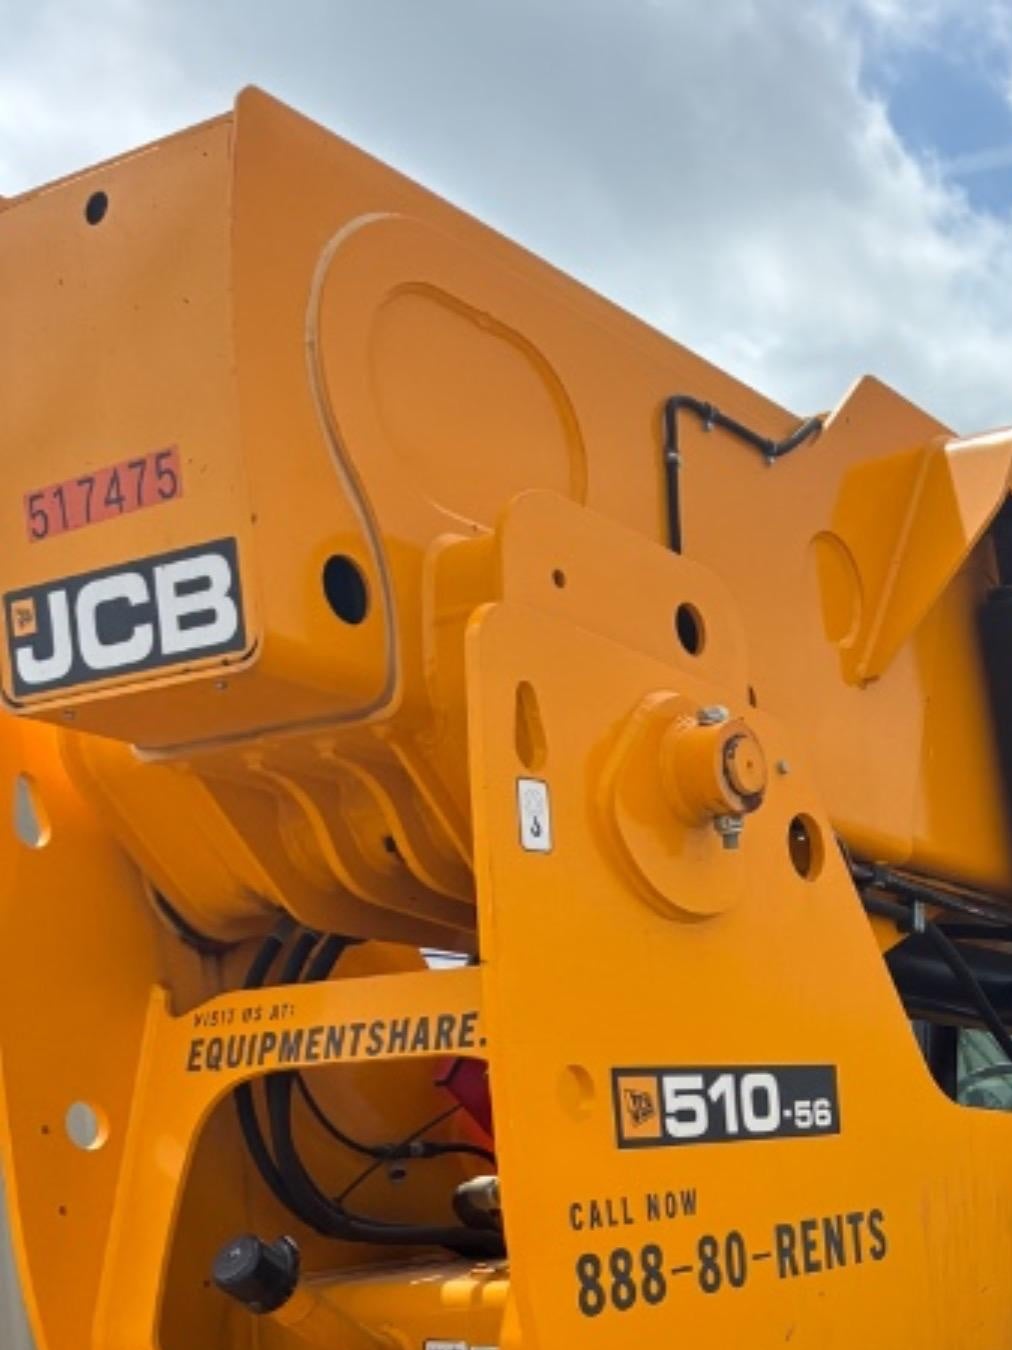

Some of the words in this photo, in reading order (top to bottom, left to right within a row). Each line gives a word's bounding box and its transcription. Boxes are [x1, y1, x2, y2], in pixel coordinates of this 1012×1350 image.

[28, 450, 178, 540] 517475
[16, 553, 238, 685] JCB
[569, 1197, 634, 1231] CALL
[646, 1188, 697, 1221] NOW
[575, 1208, 887, 1318] 888-80-RENTS
